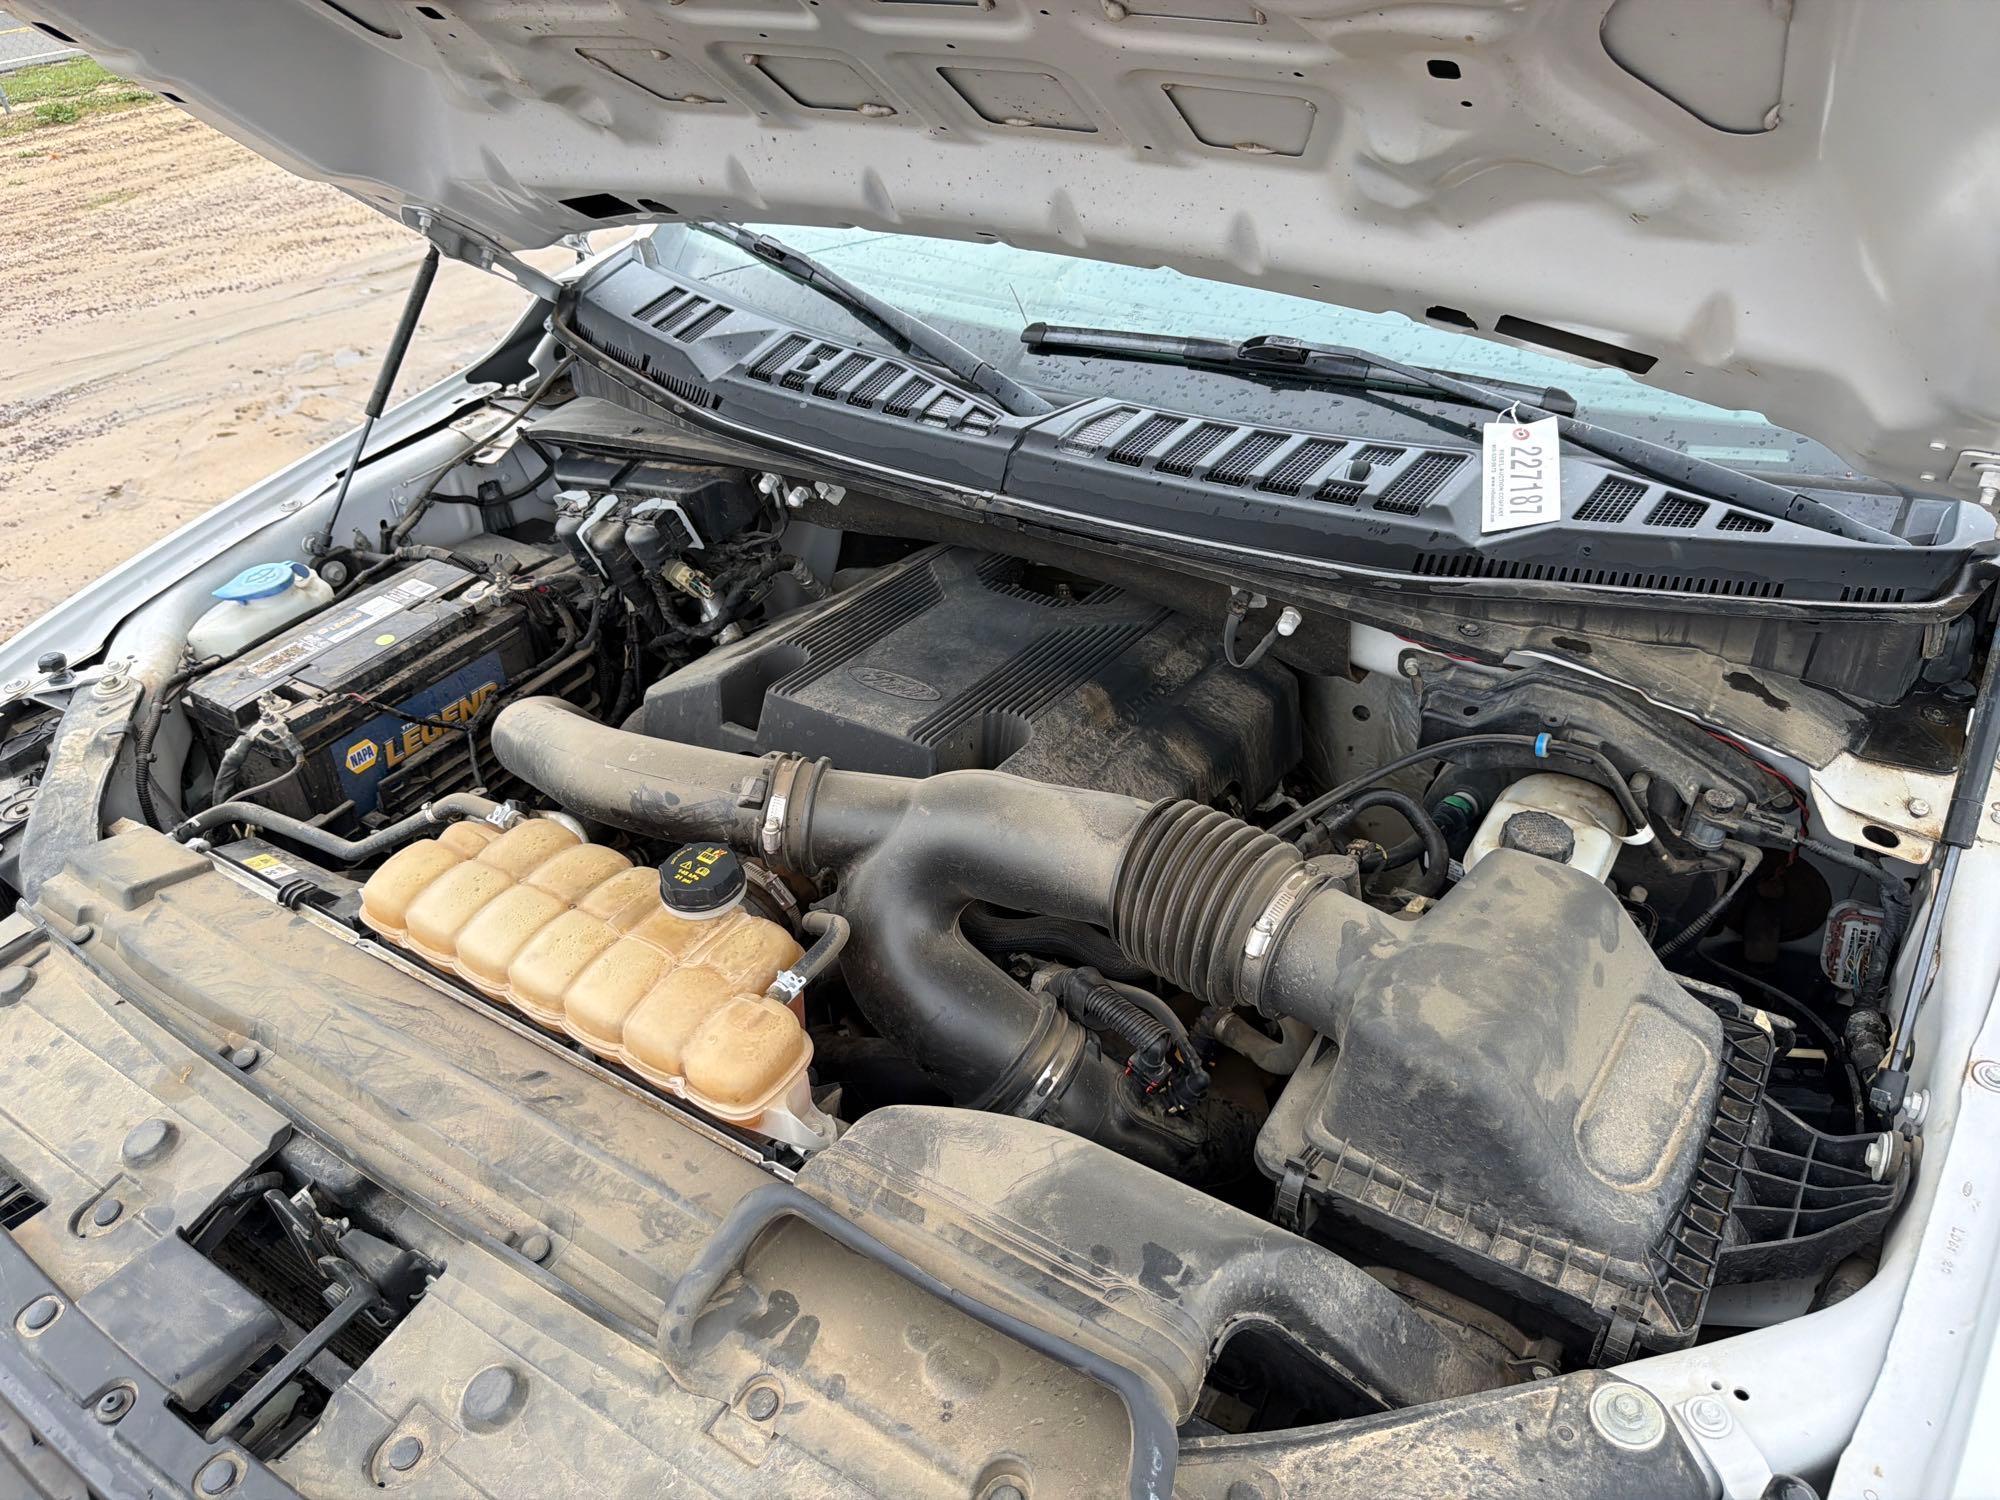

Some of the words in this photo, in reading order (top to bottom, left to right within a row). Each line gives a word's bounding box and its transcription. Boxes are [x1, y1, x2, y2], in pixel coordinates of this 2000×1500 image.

[1510, 446, 1543, 514] 227187
[857, 671, 932, 696] Ford
[350, 746, 375, 767] NAPA
[384, 681, 498, 768] LEGEND
